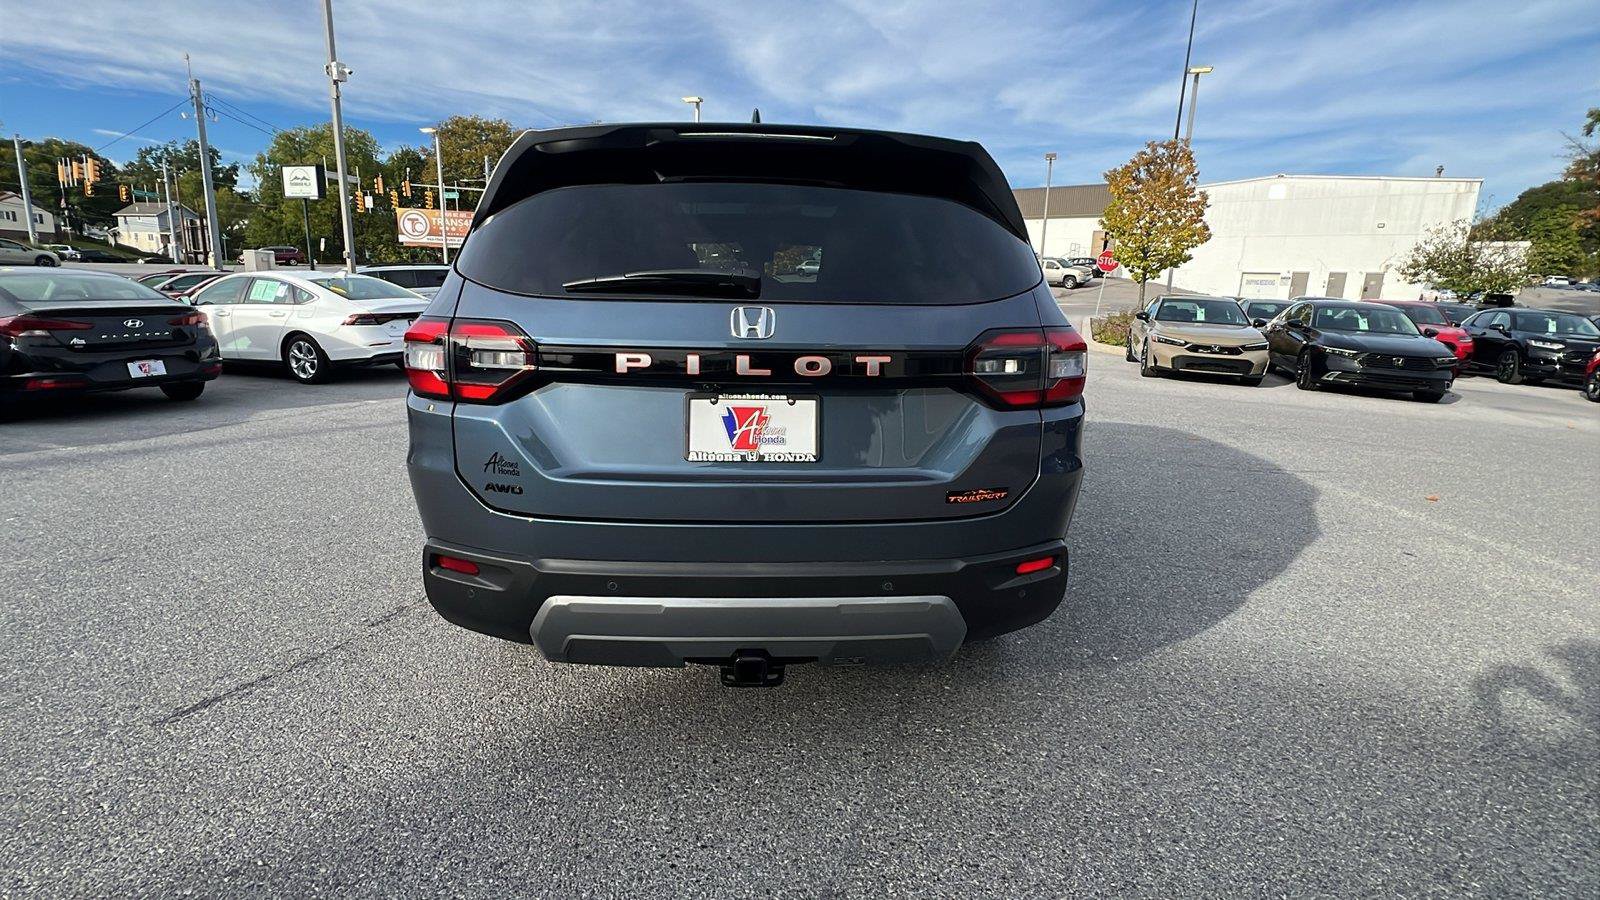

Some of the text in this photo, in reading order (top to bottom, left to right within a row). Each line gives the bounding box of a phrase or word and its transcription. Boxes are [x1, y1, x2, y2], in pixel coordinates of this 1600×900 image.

[615, 353, 892, 377] PILOT
[754, 434, 785, 445] Honda
[687, 452, 816, 462] Altoona HONDA
[498, 468, 520, 476] Honda
[485, 482, 524, 495] AWD
[948, 492, 1008, 503] TRAILSPORT
